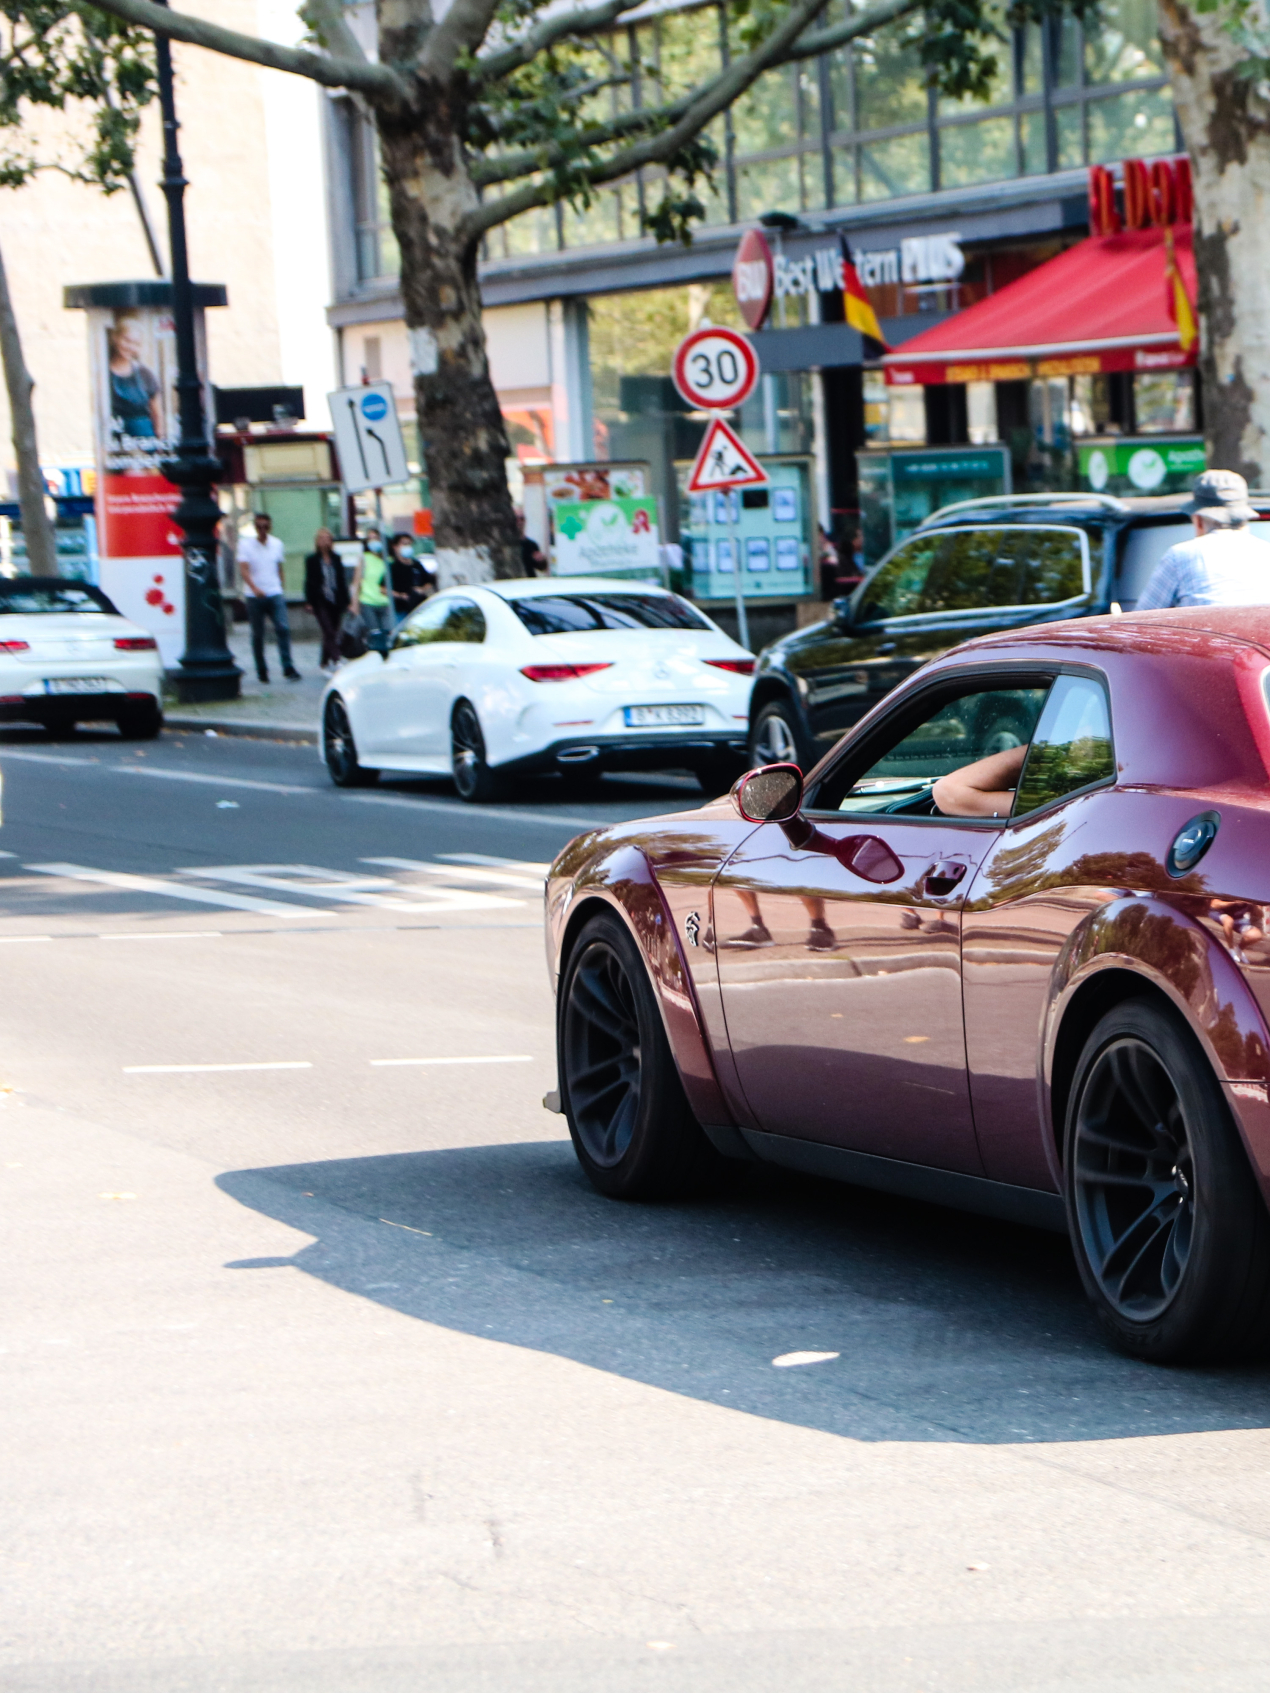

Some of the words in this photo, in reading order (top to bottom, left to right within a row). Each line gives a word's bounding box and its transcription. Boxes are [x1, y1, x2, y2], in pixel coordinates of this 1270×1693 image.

[773, 255, 813, 297] Best
[901, 232, 966, 282] PLUS
[691, 350, 738, 388] 30
